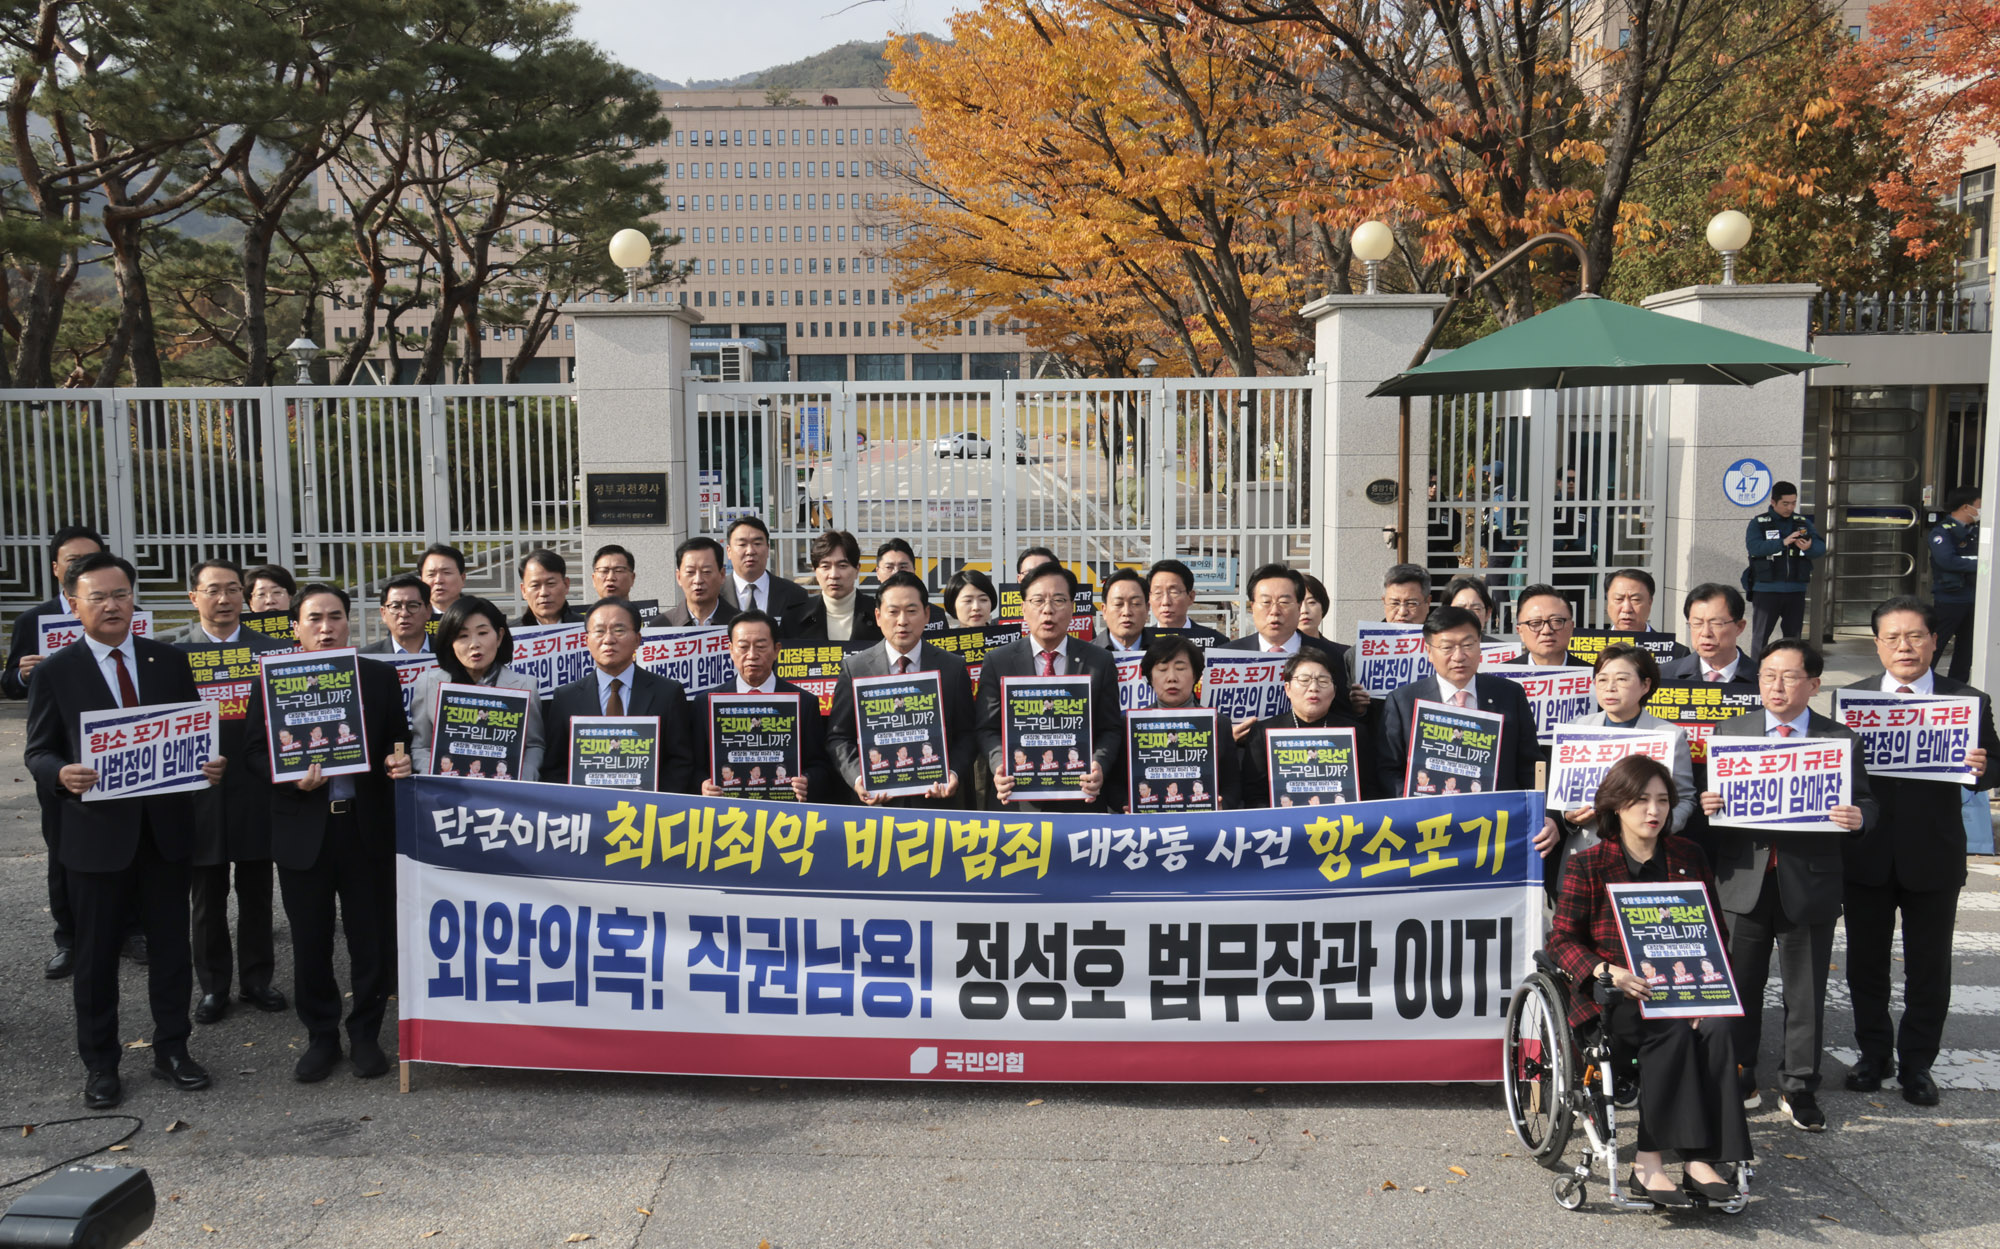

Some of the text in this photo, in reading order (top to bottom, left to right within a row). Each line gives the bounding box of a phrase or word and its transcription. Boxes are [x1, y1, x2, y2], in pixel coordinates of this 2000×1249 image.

[594, 483, 660, 496] 정부과천청사
[1736, 477, 1759, 493] 47
[1001, 592, 1023, 605] 대장
[1077, 604, 1091, 613] 지시?
[264, 616, 289, 632] 몸통
[47, 630, 77, 649] 항소
[533, 636, 561, 657] 포기
[959, 633, 984, 648] 몸통
[985, 632, 1020, 646] 누구인가?
[1362, 637, 1426, 656] 항소 포기
[222, 648, 251, 665] 몸통
[643, 644, 669, 662] 항소
[674, 636, 702, 656] 포기
[778, 647, 815, 664] 대장동
[817, 646, 843, 663] 몸통
[228, 664, 261, 678] 항소포
[778, 665, 808, 678] 이재명
[822, 663, 842, 676] 항소
[1210, 665, 1276, 685] 항소 포기
[1359, 658, 1414, 690] 사법정의
[1524, 676, 1592, 697] 포기 규탄
[276, 689, 352, 709] 누구입니까?
[1208, 687, 1263, 719] 사법정의
[1691, 688, 1722, 704] 몸통
[1723, 694, 1762, 705] 누구인가
[866, 711, 934, 729] 누구입니까?
[1696, 706, 1745, 720] 항소포기
[1845, 706, 1971, 728] 항소 포기 규탄
[90, 711, 212, 753] 항소 포기 규탄
[1014, 716, 1083, 731] 누구입니까?
[445, 724, 517, 742] 누구입니까?
[721, 733, 791, 747] 누구입니까?
[1421, 740, 1490, 764] 누구입니까?
[1560, 745, 1592, 764] 항소
[1857, 728, 1969, 765] 법정의 암매장
[89, 733, 211, 793] 사법정의 암매장
[579, 756, 649, 769] 누구입니까?
[1138, 749, 1208, 763] 누구입니까?
[1716, 749, 1843, 777] 항소 포기 규탄
[1279, 765, 1348, 778] 누구입니까?
[1716, 772, 1843, 817] 사법정의 암매장
[432, 800, 1510, 882] 단군이래 최대최악 비리범죄 대장동 사건 항소포기
[1631, 924, 1707, 940] 누구입니까?
[428, 898, 1513, 1023] 외압의혹! 직권남용! 정성호 법무장관 OUT!
[944, 1051, 1025, 1074] 국민의힘
